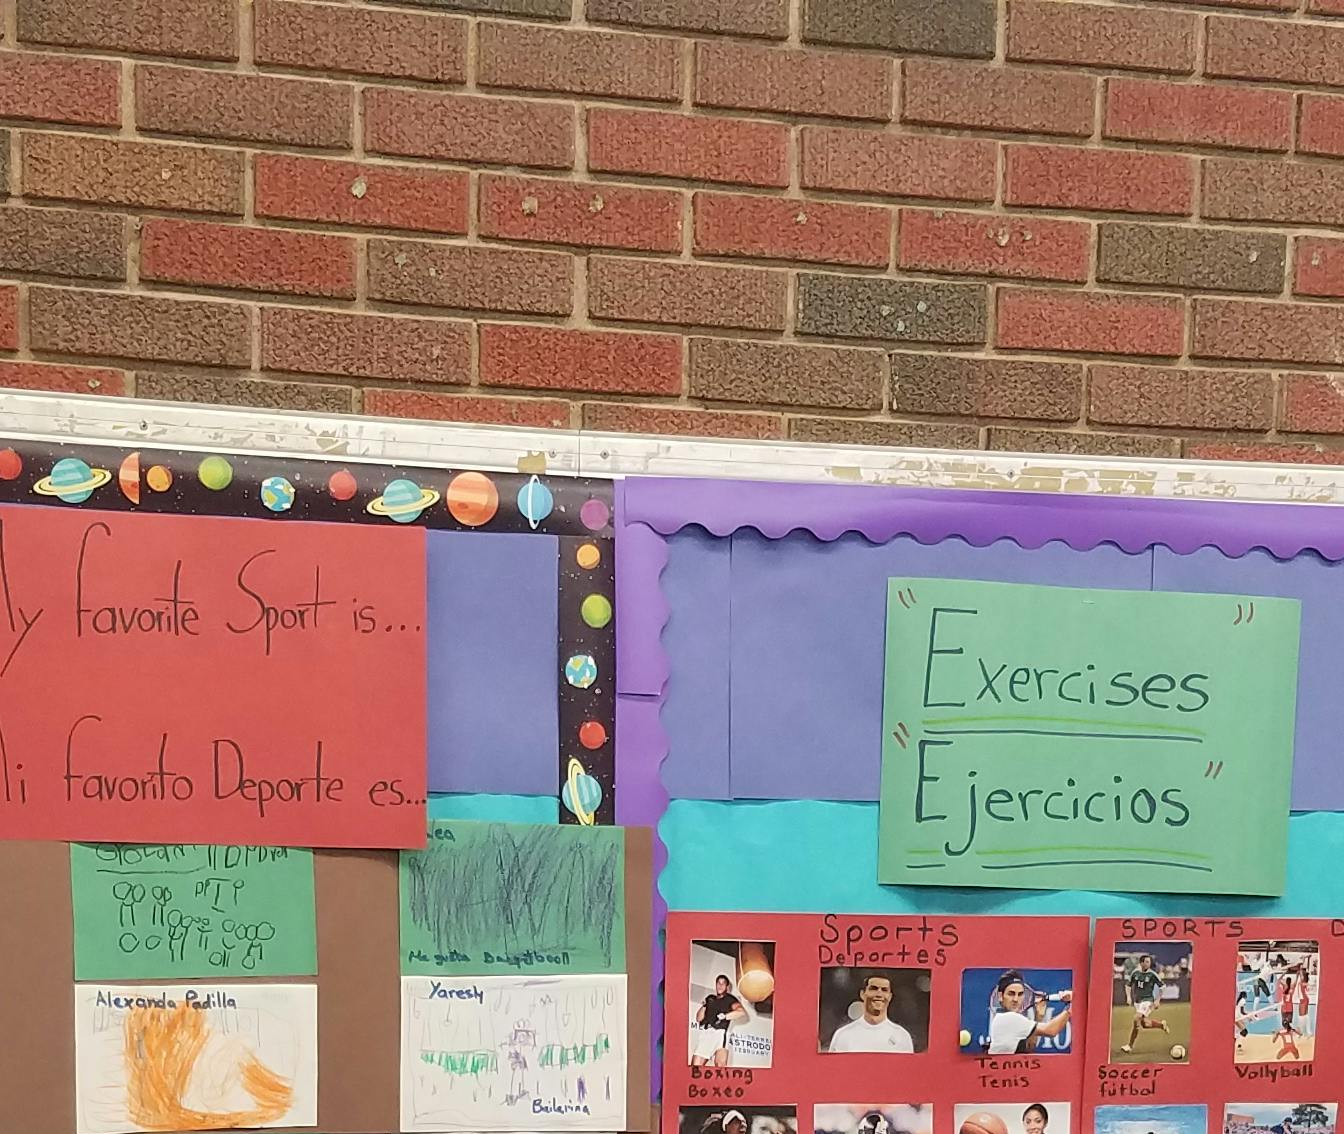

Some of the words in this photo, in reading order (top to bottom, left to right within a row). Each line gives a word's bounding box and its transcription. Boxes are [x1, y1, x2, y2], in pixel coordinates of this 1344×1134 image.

[227, 549, 337, 656] Sport
[212, 737, 346, 818] Deporte
[820, 914, 960, 956] Sports
[1122, 919, 1245, 939] SPORTS
[818, 946, 948, 968] Deportes
[185, 988, 238, 1009] Padilla
[428, 981, 484, 1004] Yaresly
[974, 1056, 1042, 1071] Tennis
[1097, 1064, 1164, 1081] Soccer
[690, 1066, 754, 1085] Boxing
[978, 1074, 1031, 1089] Tenis
[1234, 1064, 1314, 1084] Vollyball
[688, 1085, 746, 1099] Boxeo
